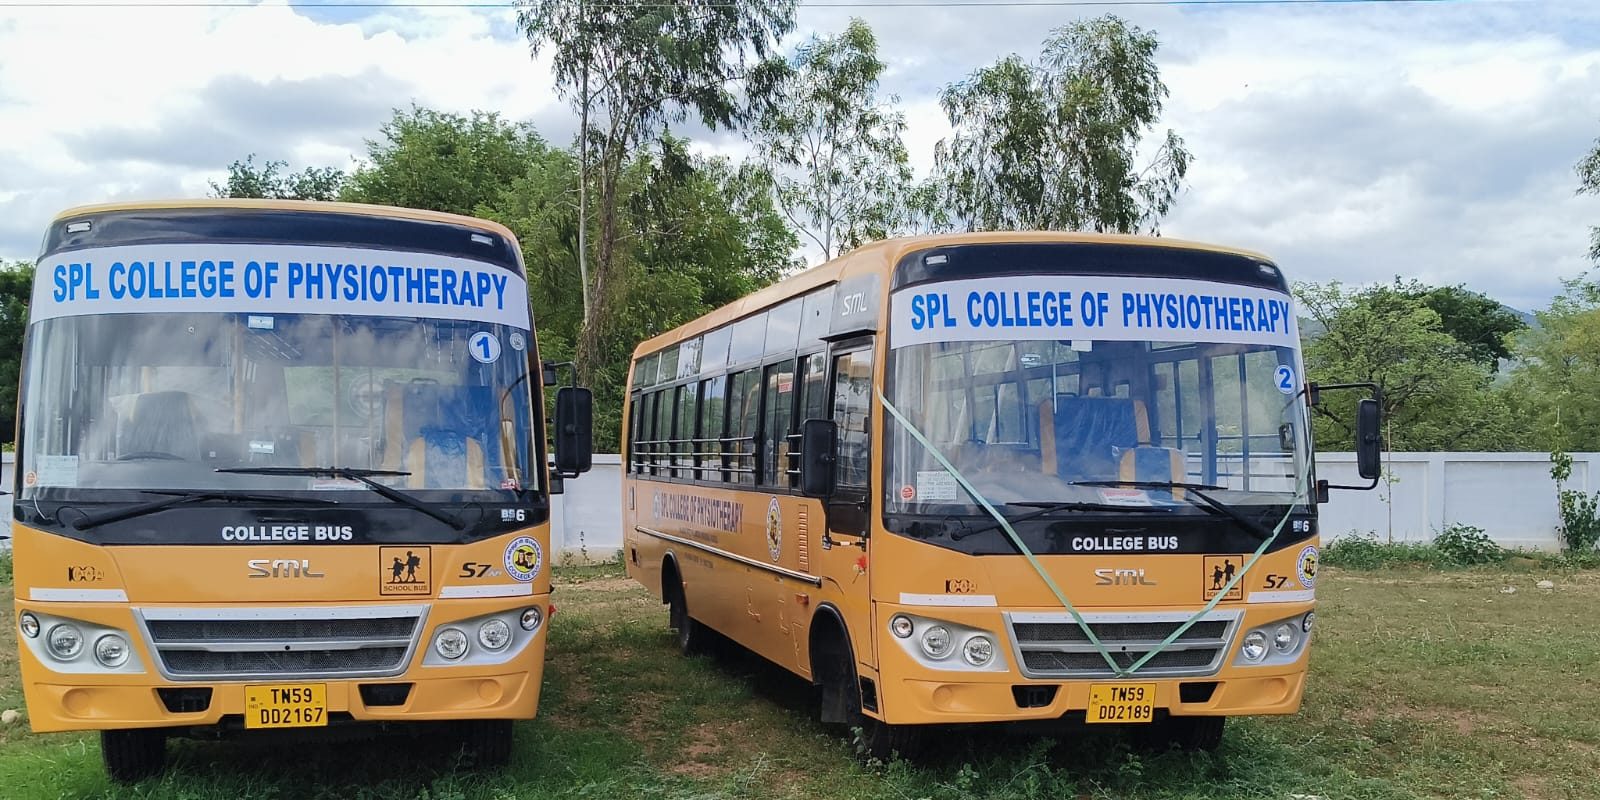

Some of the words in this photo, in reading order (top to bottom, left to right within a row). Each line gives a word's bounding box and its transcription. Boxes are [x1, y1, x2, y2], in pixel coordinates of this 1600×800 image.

[53, 262, 100, 303] SPL
[108, 260, 235, 300] COLLEGE
[244, 261, 279, 299] OF
[288, 262, 508, 310] PHYSIOTHERAPY
[911, 293, 957, 331] SPL
[966, 291, 1073, 328] COLLEGE
[1080, 291, 1109, 327] OF
[1122, 292, 1290, 335] PHYSIOTHERAPY
[476, 335, 491, 359] 1
[1279, 368, 1292, 389] 2
[697, 496, 744, 534] PHYSIOTHERAPY
[221, 525, 310, 541] COLLEGE
[314, 525, 353, 541] BUS
[1072, 536, 1144, 551] COLLEGE
[1147, 536, 1178, 550] BUS
[270, 687, 313, 704] TN59
[1111, 687, 1144, 702] TN59
[260, 707, 324, 725] DD2167
[1099, 705, 1151, 720] DD2189
